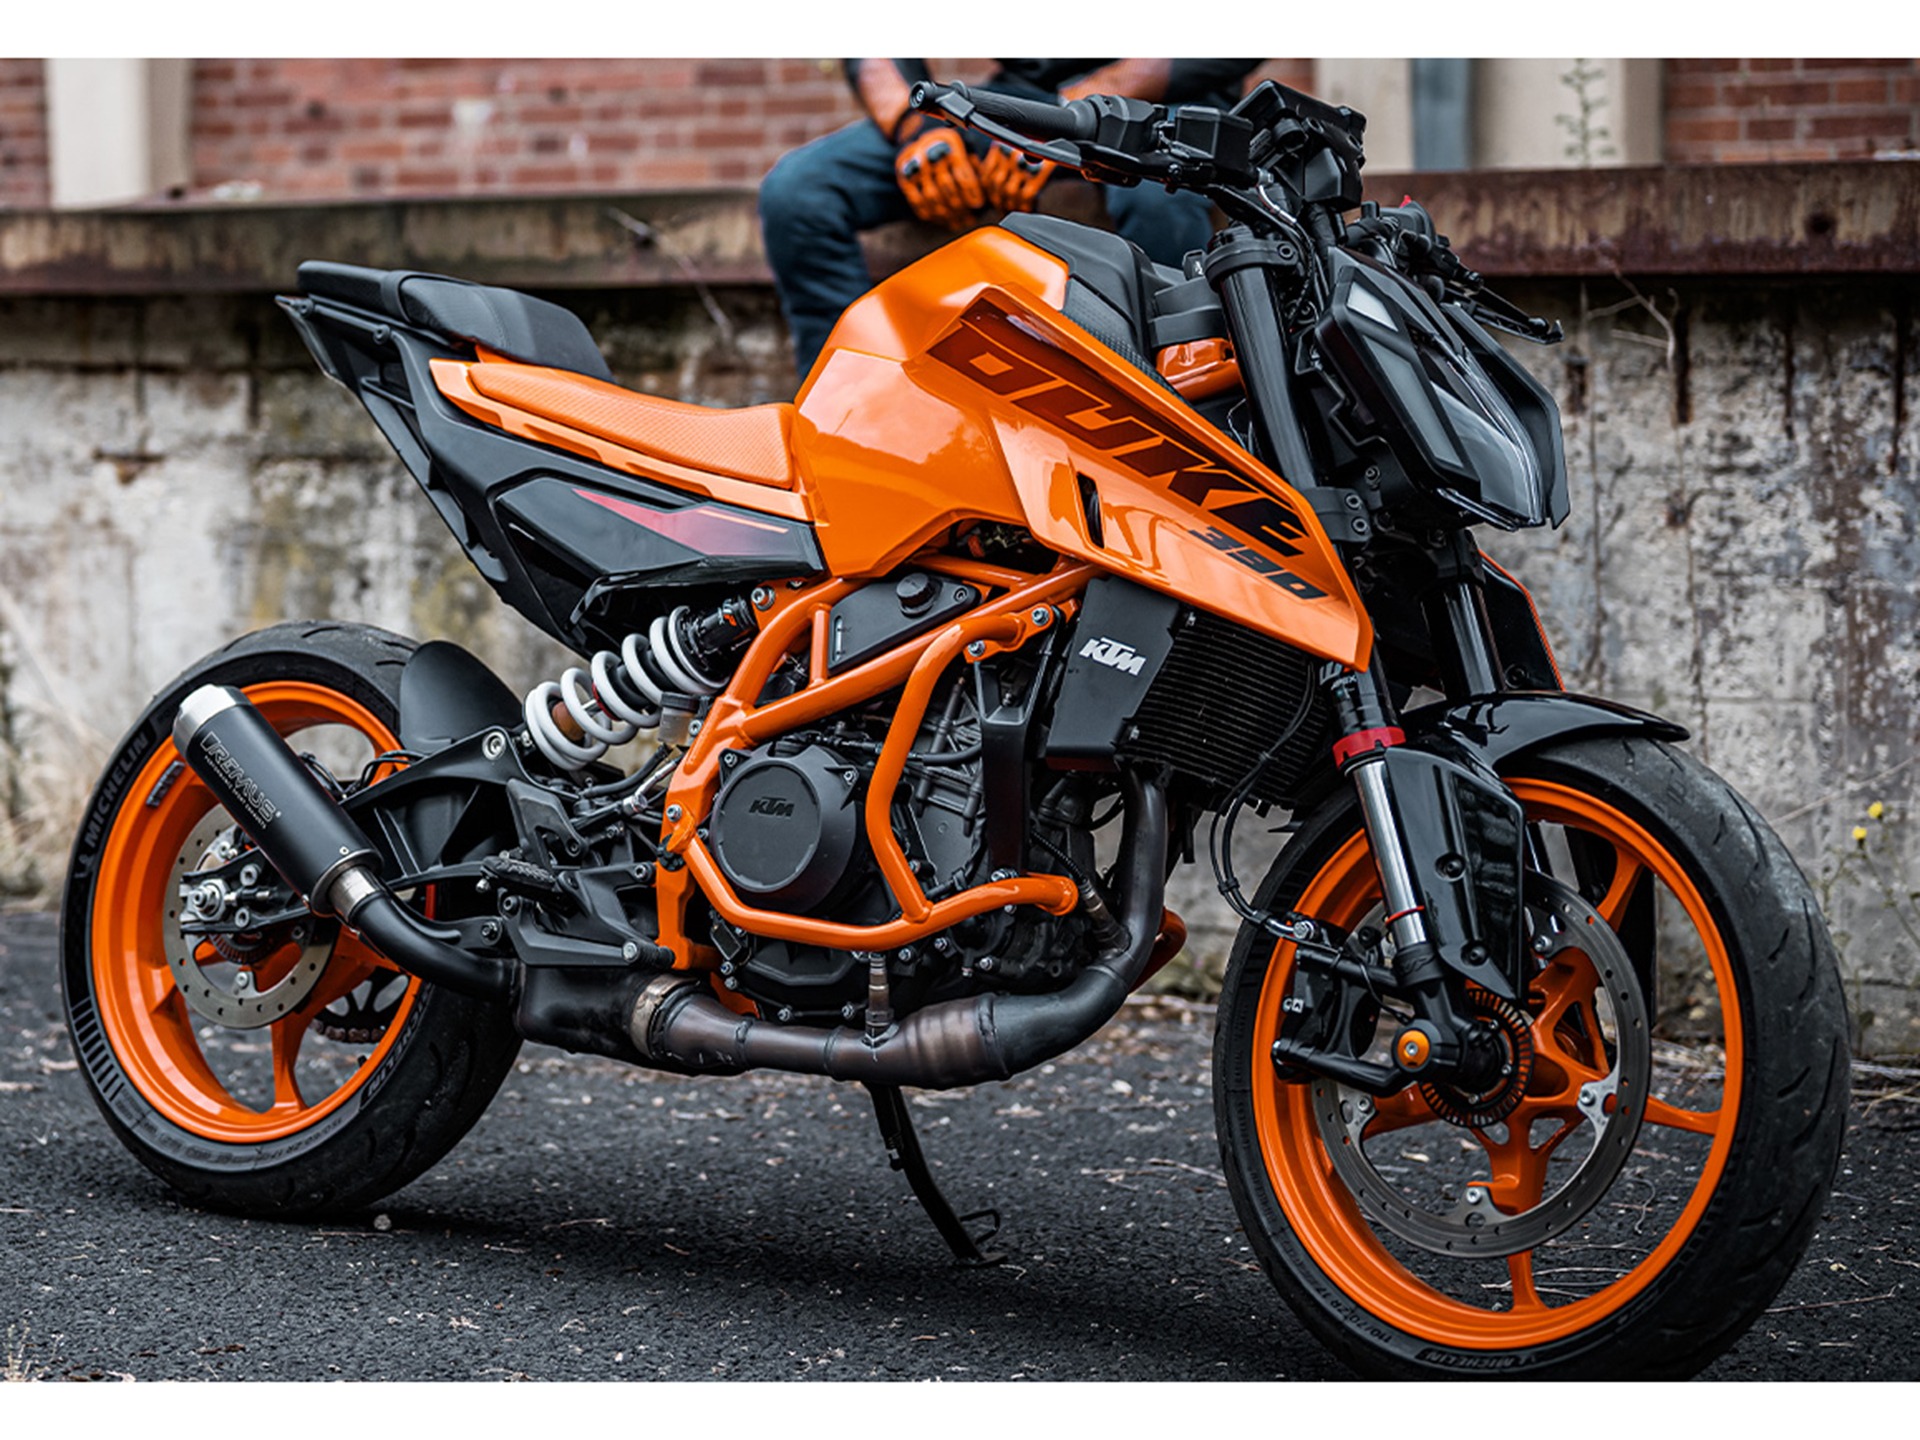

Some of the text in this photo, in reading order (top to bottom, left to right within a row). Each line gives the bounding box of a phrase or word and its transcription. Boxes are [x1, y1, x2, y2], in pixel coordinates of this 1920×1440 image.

[926, 323, 1309, 558] DUKE
[1188, 526, 1328, 600] 390
[1079, 637, 1146, 676] KTM
[84, 732, 148, 849] MICHELIN
[207, 743, 277, 823] REMUS
[749, 796, 795, 817] KTM
[1425, 1351, 1513, 1368] MICHELIN
